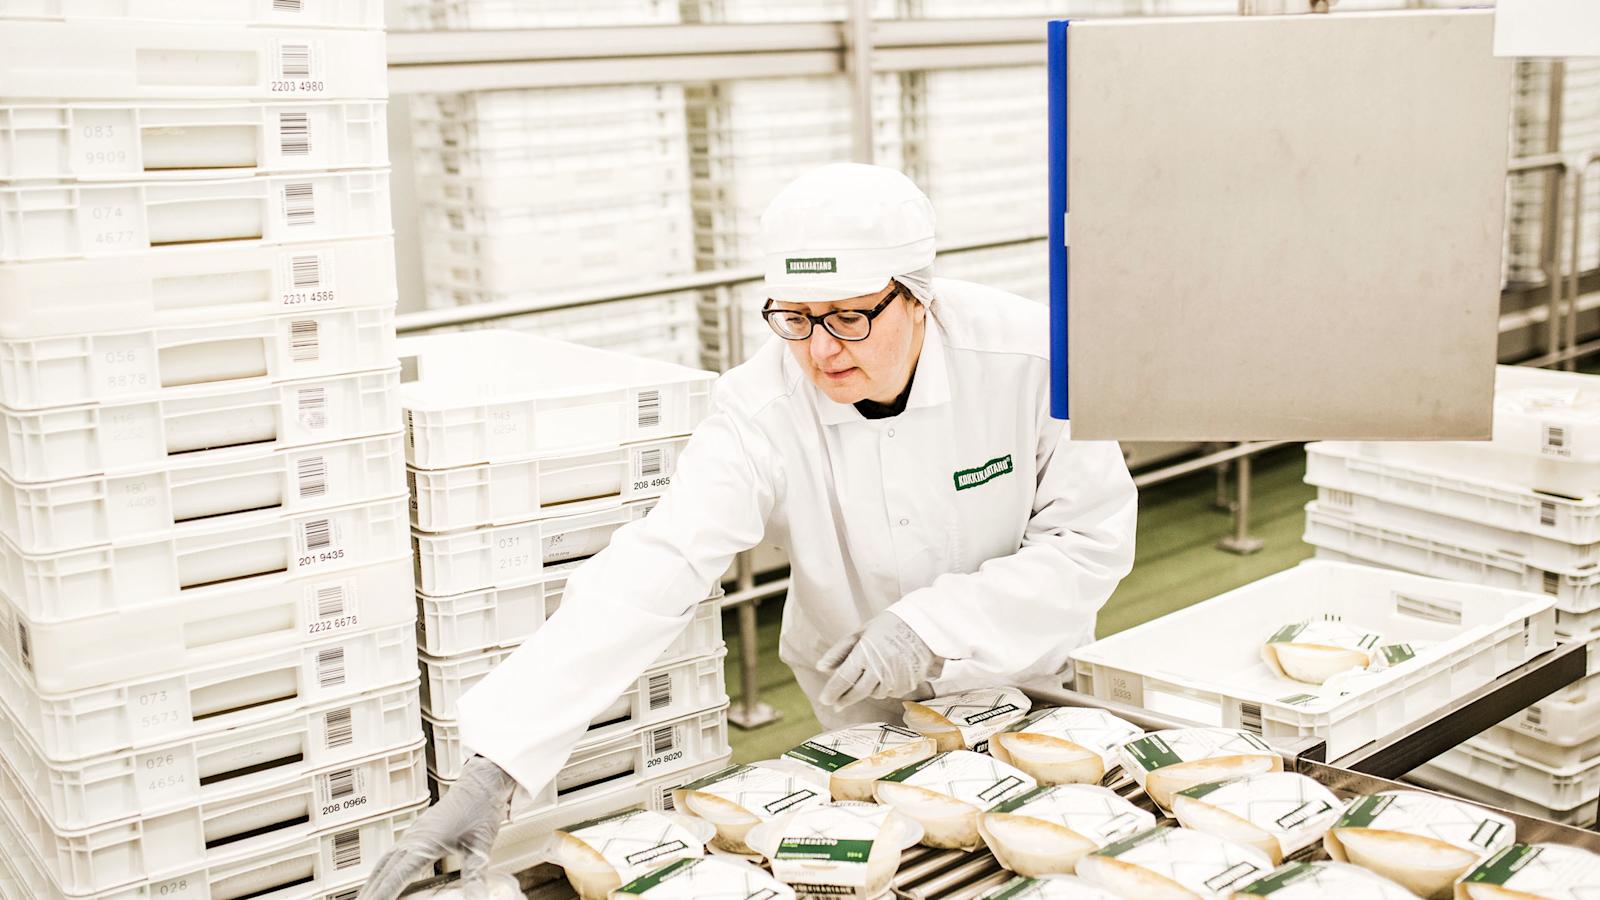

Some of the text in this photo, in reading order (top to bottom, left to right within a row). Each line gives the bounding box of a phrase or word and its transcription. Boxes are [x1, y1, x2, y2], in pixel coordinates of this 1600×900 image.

[271, 80, 324, 92] 2203 4980
[83, 125, 114, 138] 083
[86, 151, 126, 164] 9909
[92, 207, 123, 219] 074
[95, 231, 134, 244] 4677
[283, 290, 334, 305] 2231 4586
[105, 350, 136, 363] 056
[633, 476, 671, 491] 208 4965
[498, 536, 520, 549] 031
[299, 549, 344, 567] 201 9435
[500, 554, 529, 569] 2157
[309, 615, 358, 634] 2232 6678
[139, 690, 168, 706] 073
[141, 710, 179, 728] 5573
[146, 754, 174, 769] 026
[647, 750, 683, 768] 209 8020
[148, 775, 185, 790] 4654
[322, 795, 367, 815] 208 0966
[160, 879, 188, 896] 028
